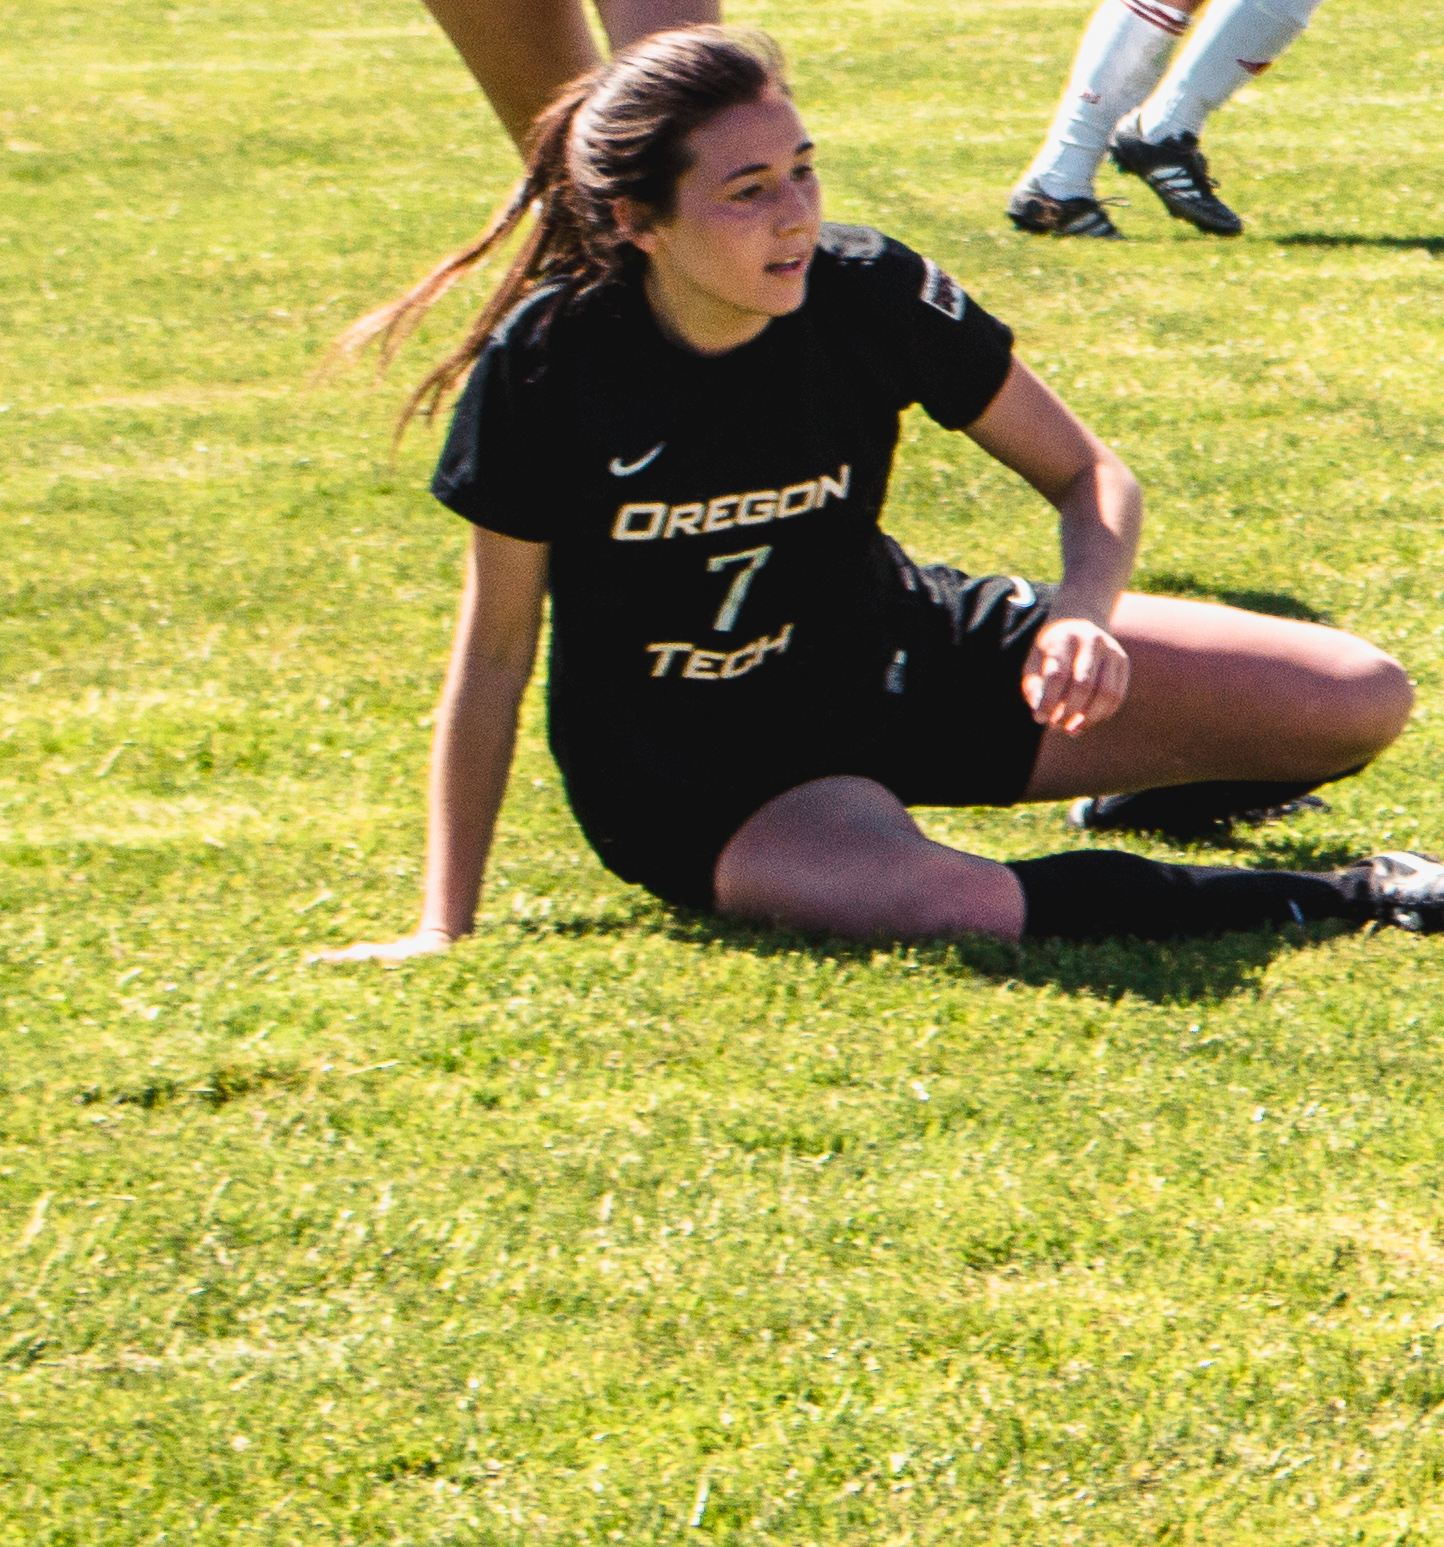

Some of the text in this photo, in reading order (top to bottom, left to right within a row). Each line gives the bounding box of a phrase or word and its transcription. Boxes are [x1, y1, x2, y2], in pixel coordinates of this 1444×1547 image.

[611, 466, 850, 541] OREGON
[707, 546, 772, 632] 7
[646, 624, 793, 680] TECH
